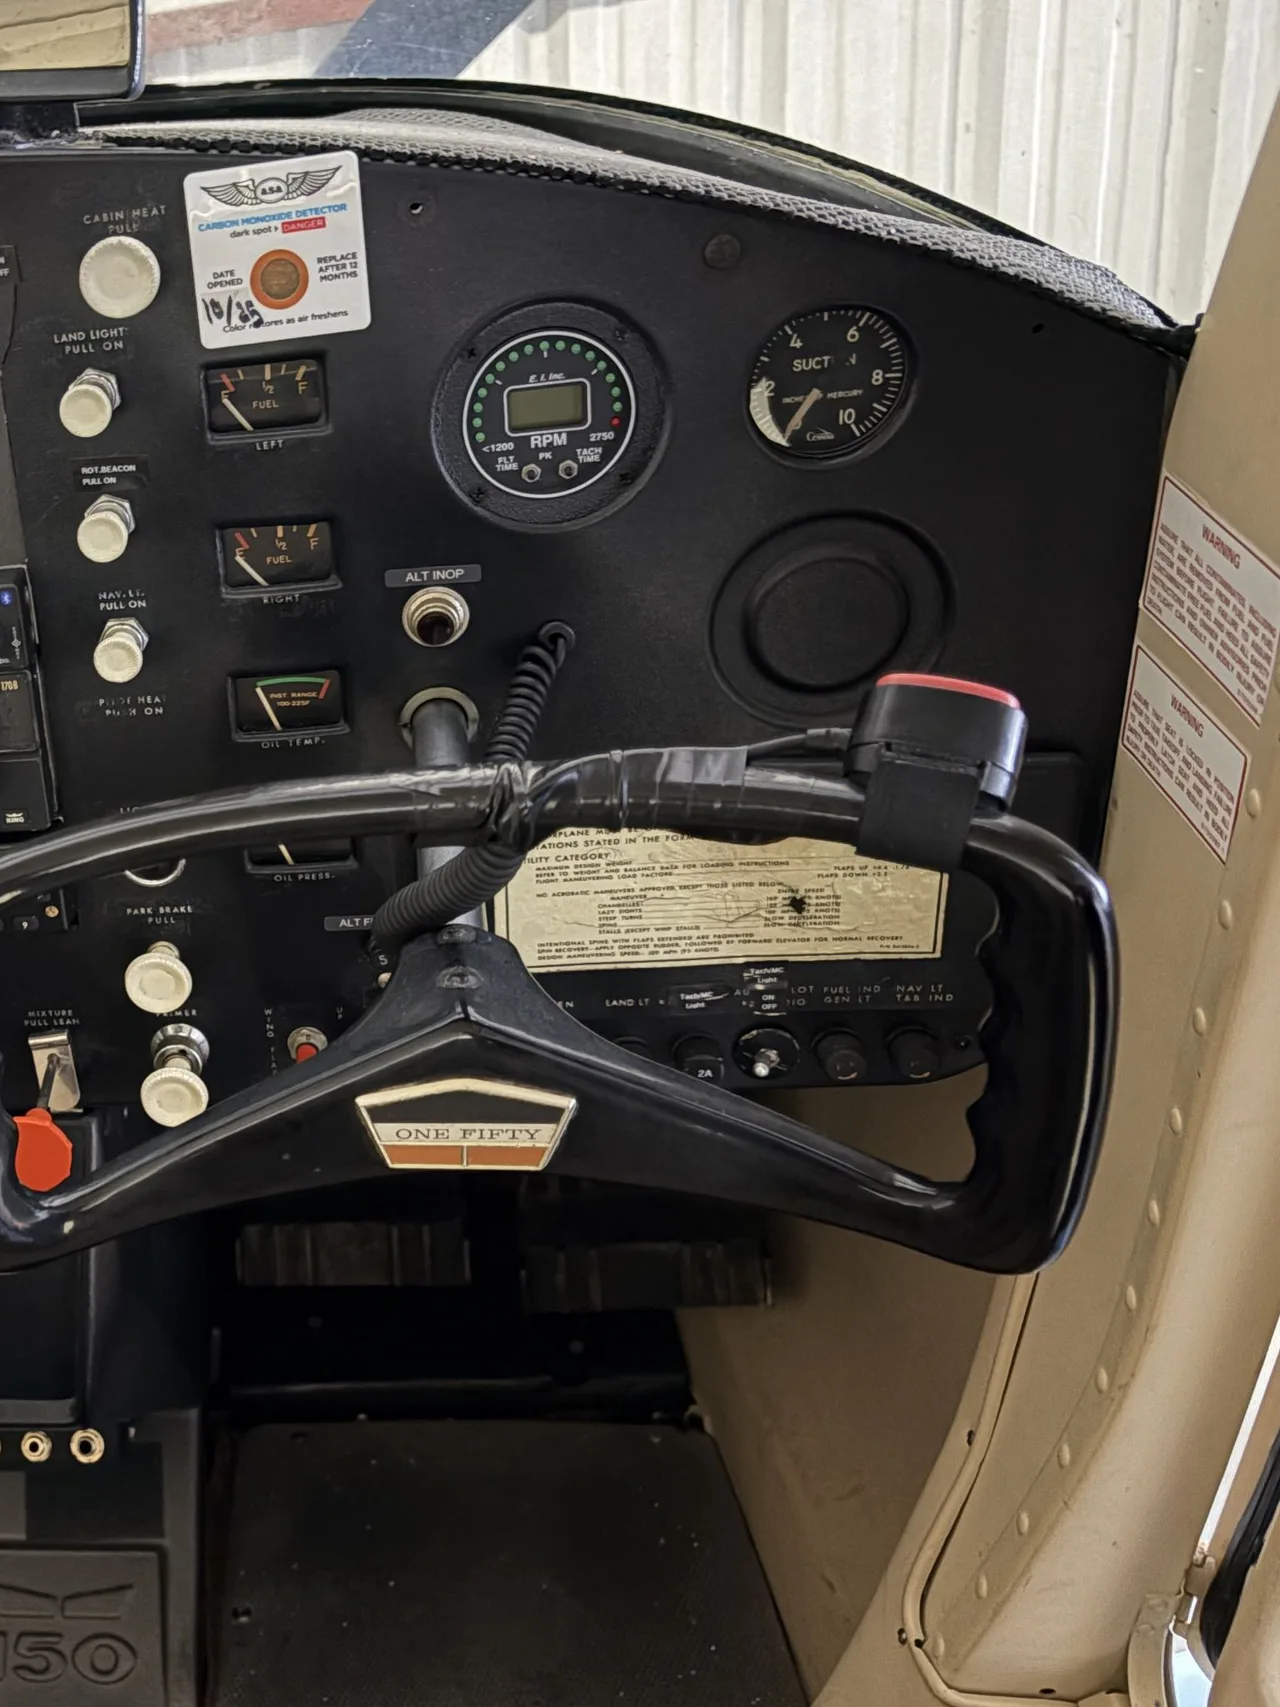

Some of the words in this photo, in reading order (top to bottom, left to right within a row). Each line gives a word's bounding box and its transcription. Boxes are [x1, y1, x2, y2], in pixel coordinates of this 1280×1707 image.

[83, 210, 124, 225] CABIN
[132, 205, 166, 219] HEAT
[198, 217, 239, 232] CARBON
[241, 211, 294, 226] MONOXIDE
[295, 203, 347, 218] DETECTOR
[108, 223, 138, 235] PULL
[230, 229, 250, 239] dark
[252, 225, 273, 237] spot
[282, 219, 324, 232] DANGER
[317, 252, 357, 265] REPLACE
[319, 263, 348, 274] AFTER
[349, 261, 358, 270] 12
[212, 270, 236, 280] DATE
[320, 270, 358, 282] MONTHS
[207, 278, 243, 290] OPENED
[223, 322, 246, 333] Color
[286, 316, 295, 324] as
[297, 314, 309, 323] air
[311, 309, 348, 321] freshens
[54, 332, 86, 344] LAND
[90, 327, 125, 340] LIGHT
[65, 343, 94, 355] PULL
[103, 340, 124, 350] ON
[252, 400, 279, 410] FUEL
[838, 408, 856, 425] 10
[530, 433, 567, 449] RPM
[589, 431, 615, 441] 2750
[256, 440, 283, 451] LEFT
[539, 451, 552, 460] PK
[576, 447, 602, 456] TACH
[497, 456, 515, 465] FLT
[578, 454, 601, 464] TIME
[496, 462, 519, 472] TIME
[82, 477, 102, 486] PULL
[103, 476, 117, 485] ON
[1202, 524, 1241, 570] WARNING
[266, 555, 293, 565] FUEL
[405, 570, 429, 582] ALT
[432, 569, 465, 581] INOP
[263, 594, 300, 604] RIGHT
[99, 601, 125, 611] PULL
[128, 600, 147, 609] ON
[1, 681, 18, 692] 170B
[1170, 694, 1205, 739] WARNING
[261, 740, 280, 749] OIL
[289, 738, 325, 747] TEMP.
[584, 838, 620, 848] STATED
[625, 837, 637, 845] IN
[642, 835, 659, 844] THE
[555, 852, 610, 863] CATEGORY
[274, 874, 293, 882] OIL
[126, 907, 153, 915] PARK
[158, 905, 193, 914] BRAKE
[148, 916, 176, 924] PULL
[339, 917, 361, 928] ALT
[757, 977, 777, 985] Light
[823, 986, 851, 994] FUEL
[896, 984, 922, 992] NAV
[931, 984, 944, 992] LT
[605, 998, 634, 1007] LAND
[639, 998, 650, 1006] LT
[824, 996, 850, 1004] GEN
[858, 995, 870, 1003] LT
[686, 1002, 705, 1010] Light
[27, 1009, 73, 1017] MIXTURE
[24, 1018, 49, 1026] PULL
[53, 1017, 80, 1026] LEAN
[697, 1069, 713, 1077] 2A
[395, 1127, 450, 1140] ONE
[460, 1127, 543, 1140] FIFTY
